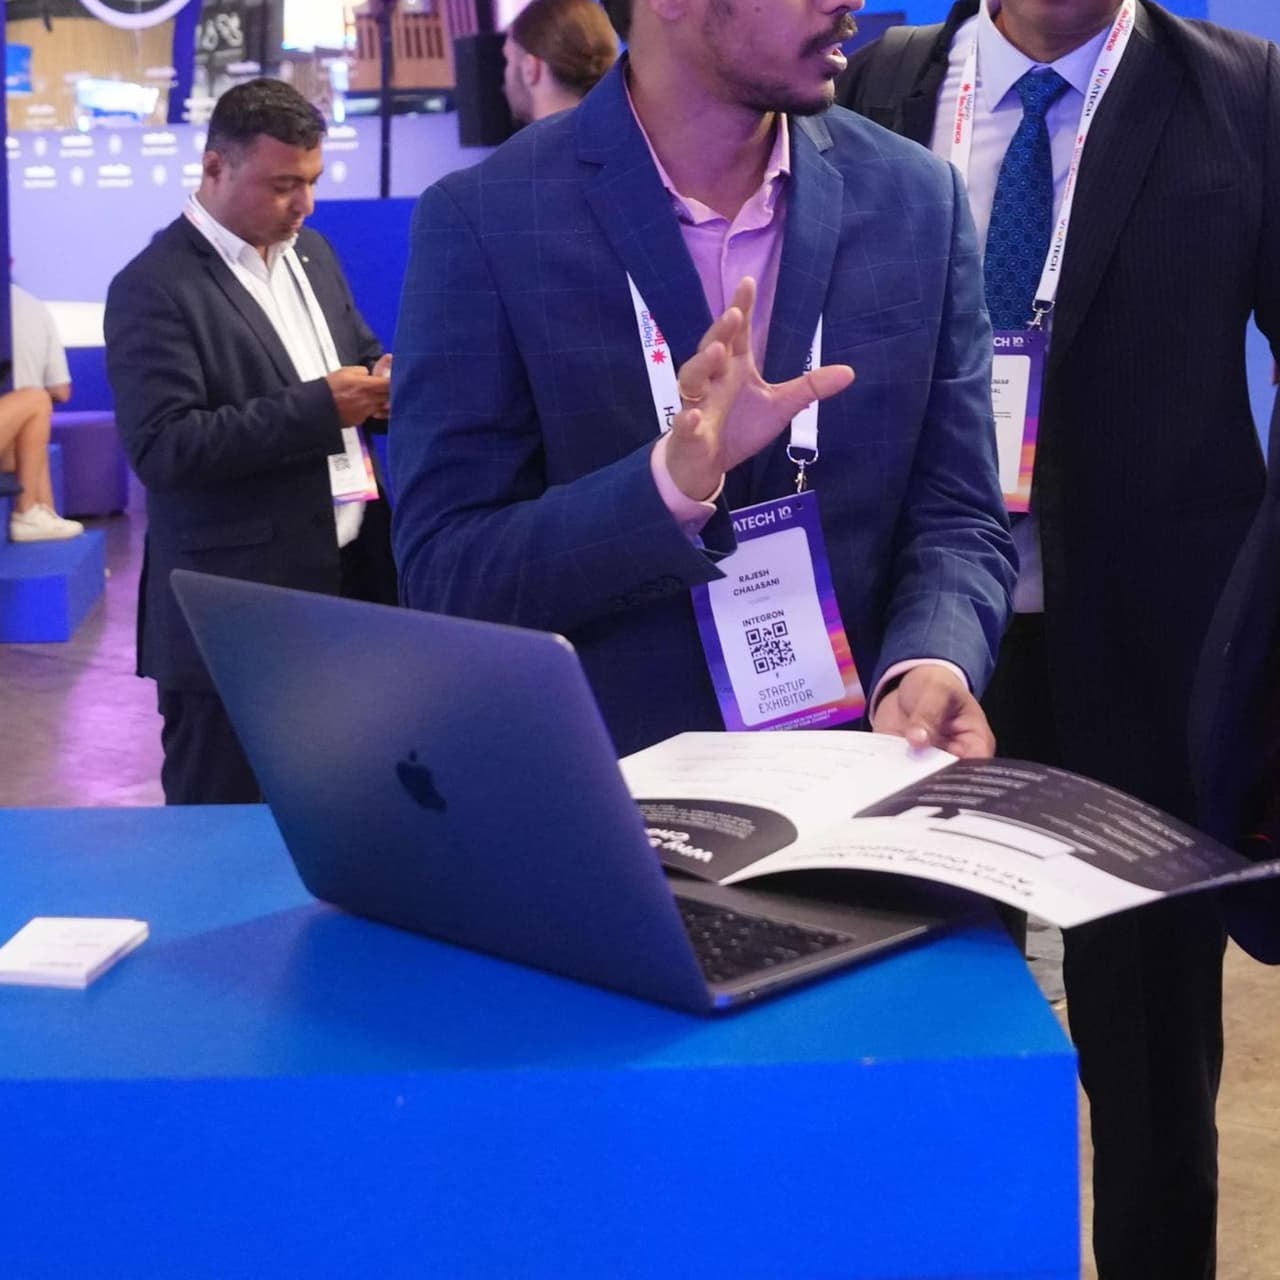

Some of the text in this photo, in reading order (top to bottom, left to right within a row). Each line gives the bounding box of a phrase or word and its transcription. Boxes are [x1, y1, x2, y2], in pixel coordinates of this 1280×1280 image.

[739, 569, 770, 583] RAJESH
[733, 578, 780, 596] CHALASANI
[742, 610, 785, 627] INTEGRON
[758, 679, 806, 700] STARTUP
[759, 689, 815, 714] EXHIBITOR
